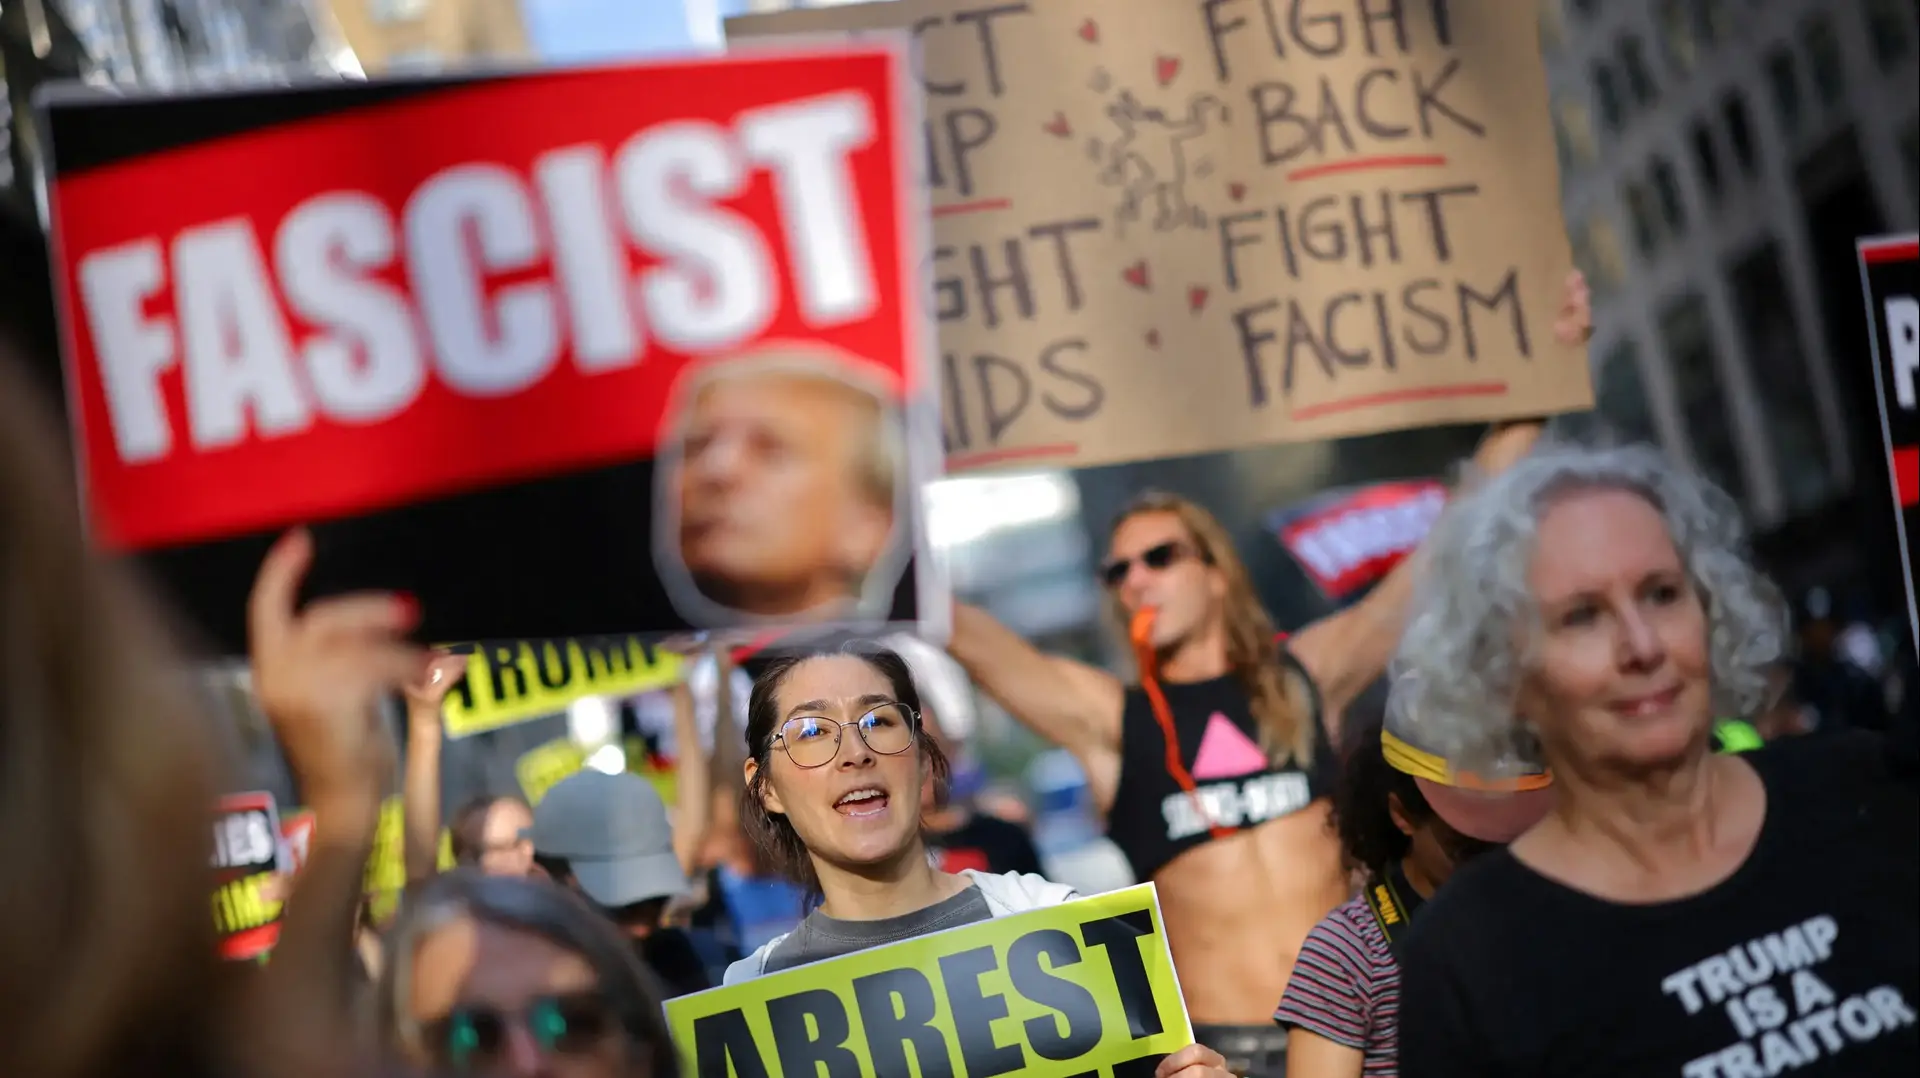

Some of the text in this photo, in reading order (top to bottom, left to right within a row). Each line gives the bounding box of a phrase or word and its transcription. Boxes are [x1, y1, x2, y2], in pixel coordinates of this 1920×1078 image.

[912, 2, 1032, 98] CT
[1249, 58, 1487, 166] BACK
[78, 88, 878, 465] FASCIST
[1218, 183, 1480, 292] FIGHT
[1231, 265, 1533, 409] FACISM
[942, 336, 1106, 454] IDS
[210, 811, 273, 868] IES
[693, 908, 1164, 1078] ARREST
[1661, 914, 1839, 1016] TRUMP
[1725, 968, 1836, 1040] IS A
[1681, 985, 1917, 1078] TRAITOR
